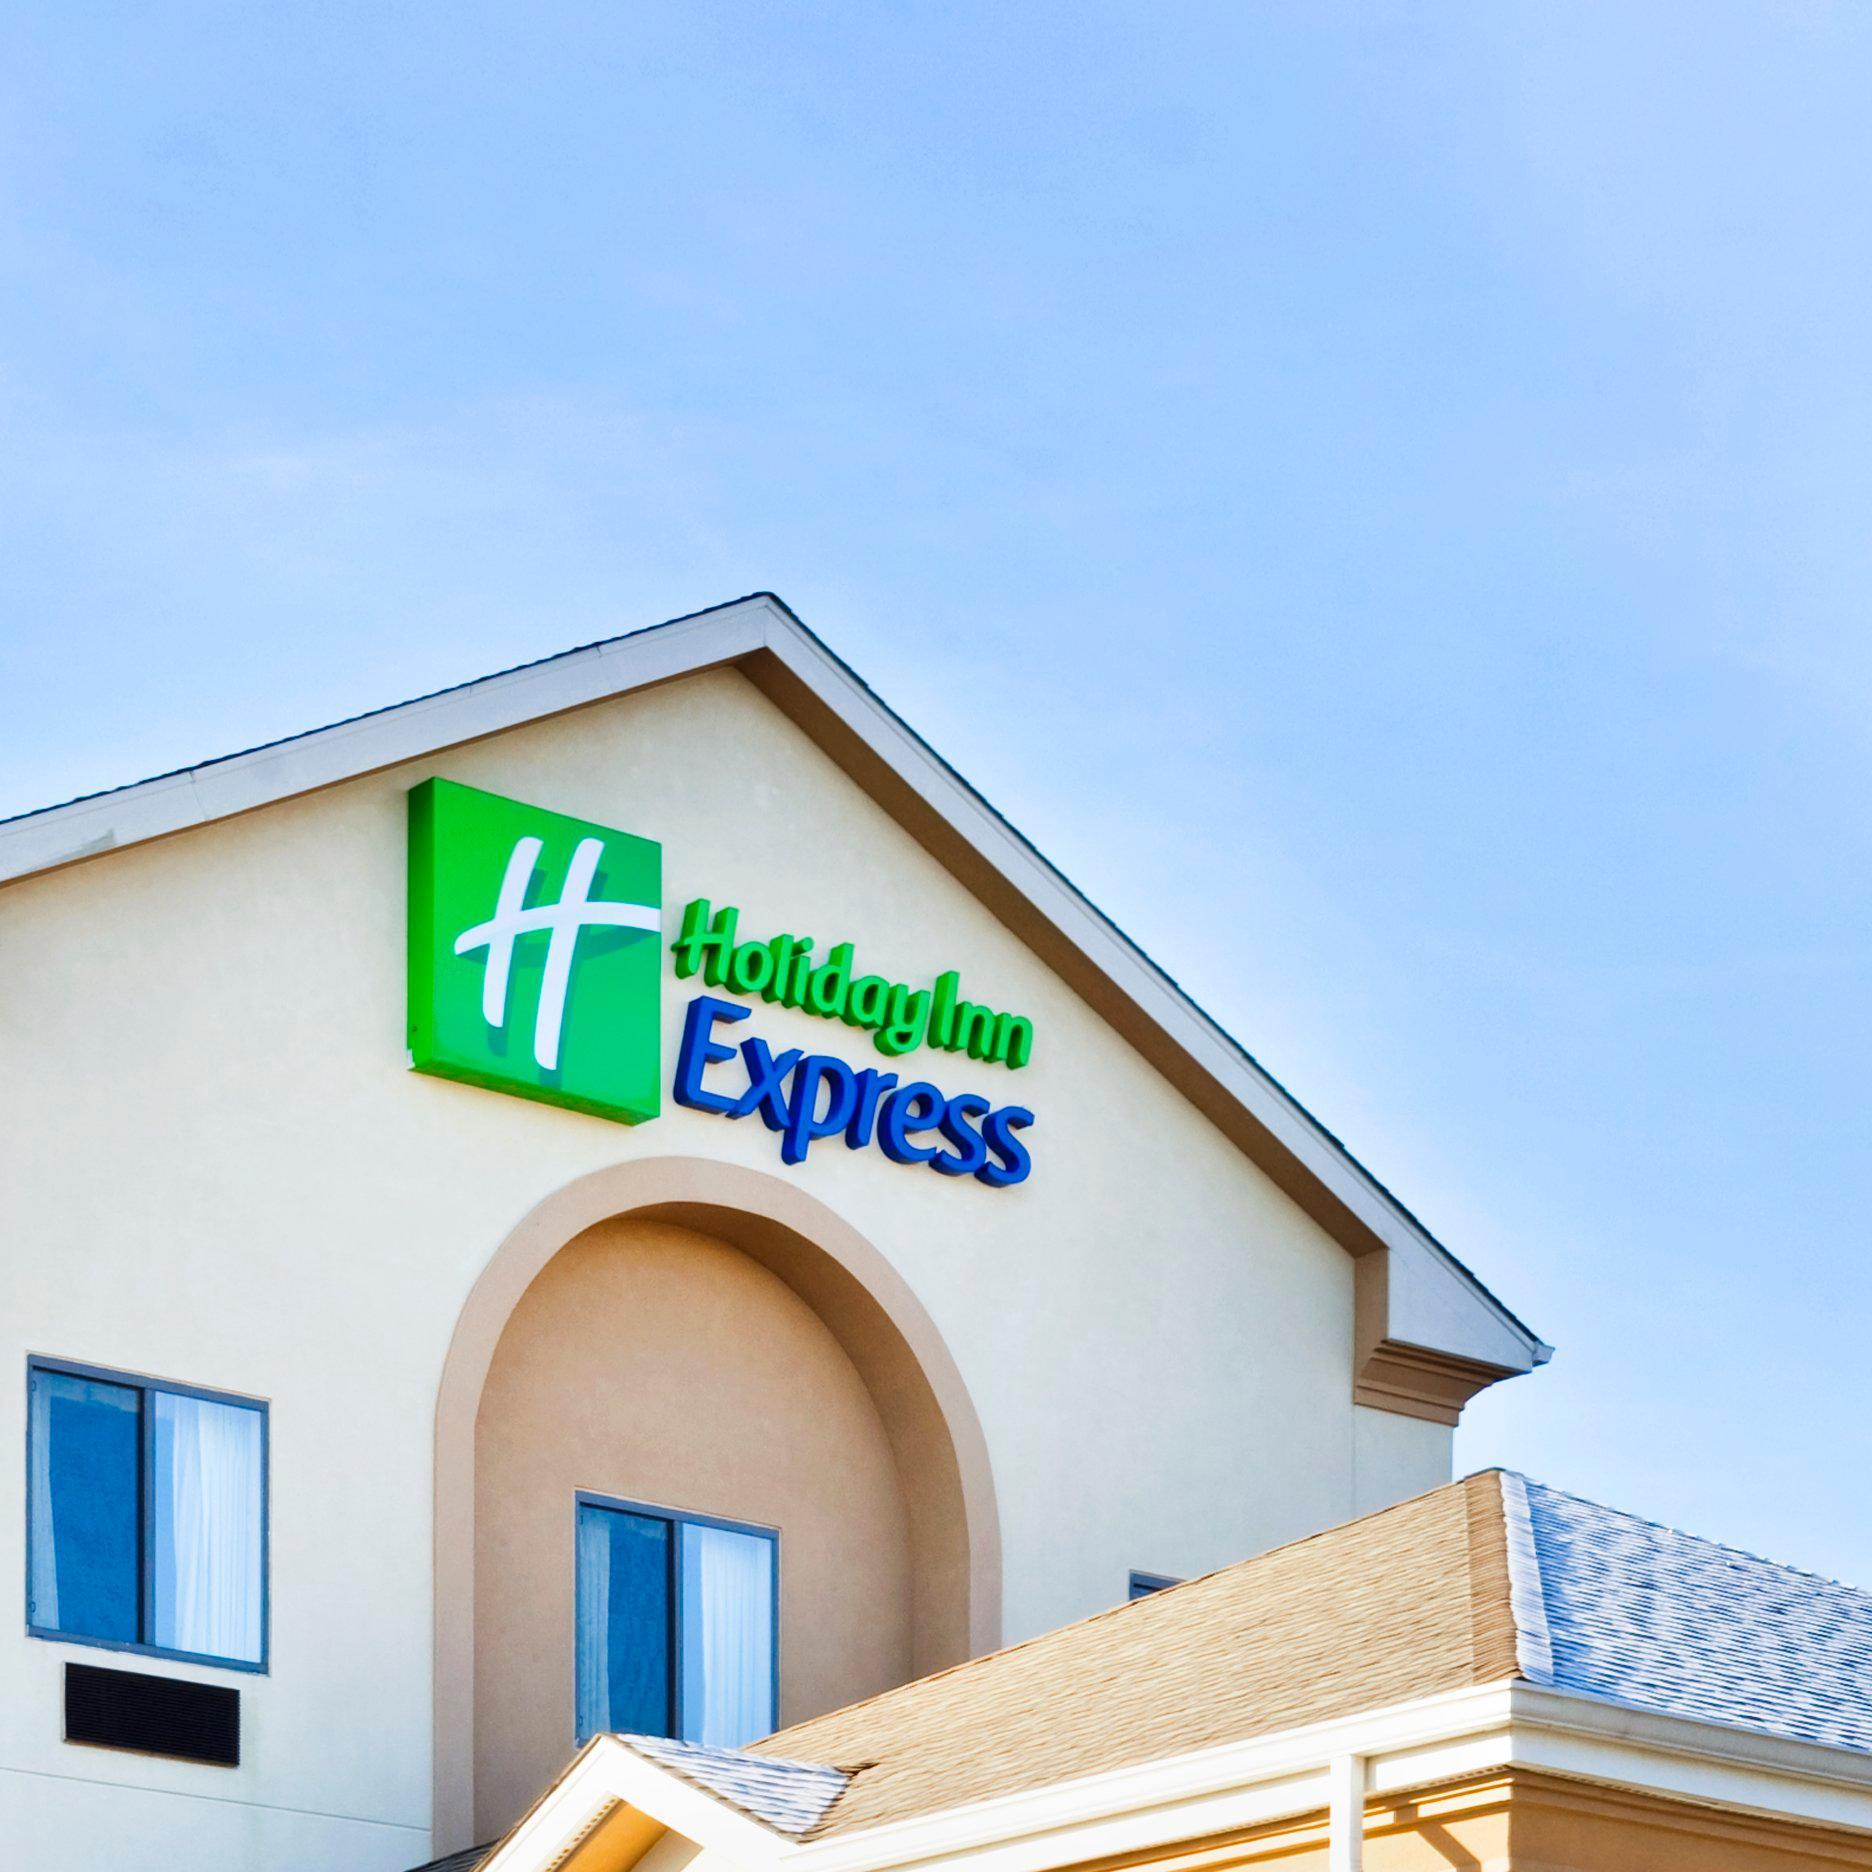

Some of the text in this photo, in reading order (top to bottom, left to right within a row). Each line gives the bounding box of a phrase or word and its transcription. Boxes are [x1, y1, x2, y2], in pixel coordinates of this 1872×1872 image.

[671, 898, 1033, 1069] Holiday Inn
[673, 995, 1035, 1188] Express
